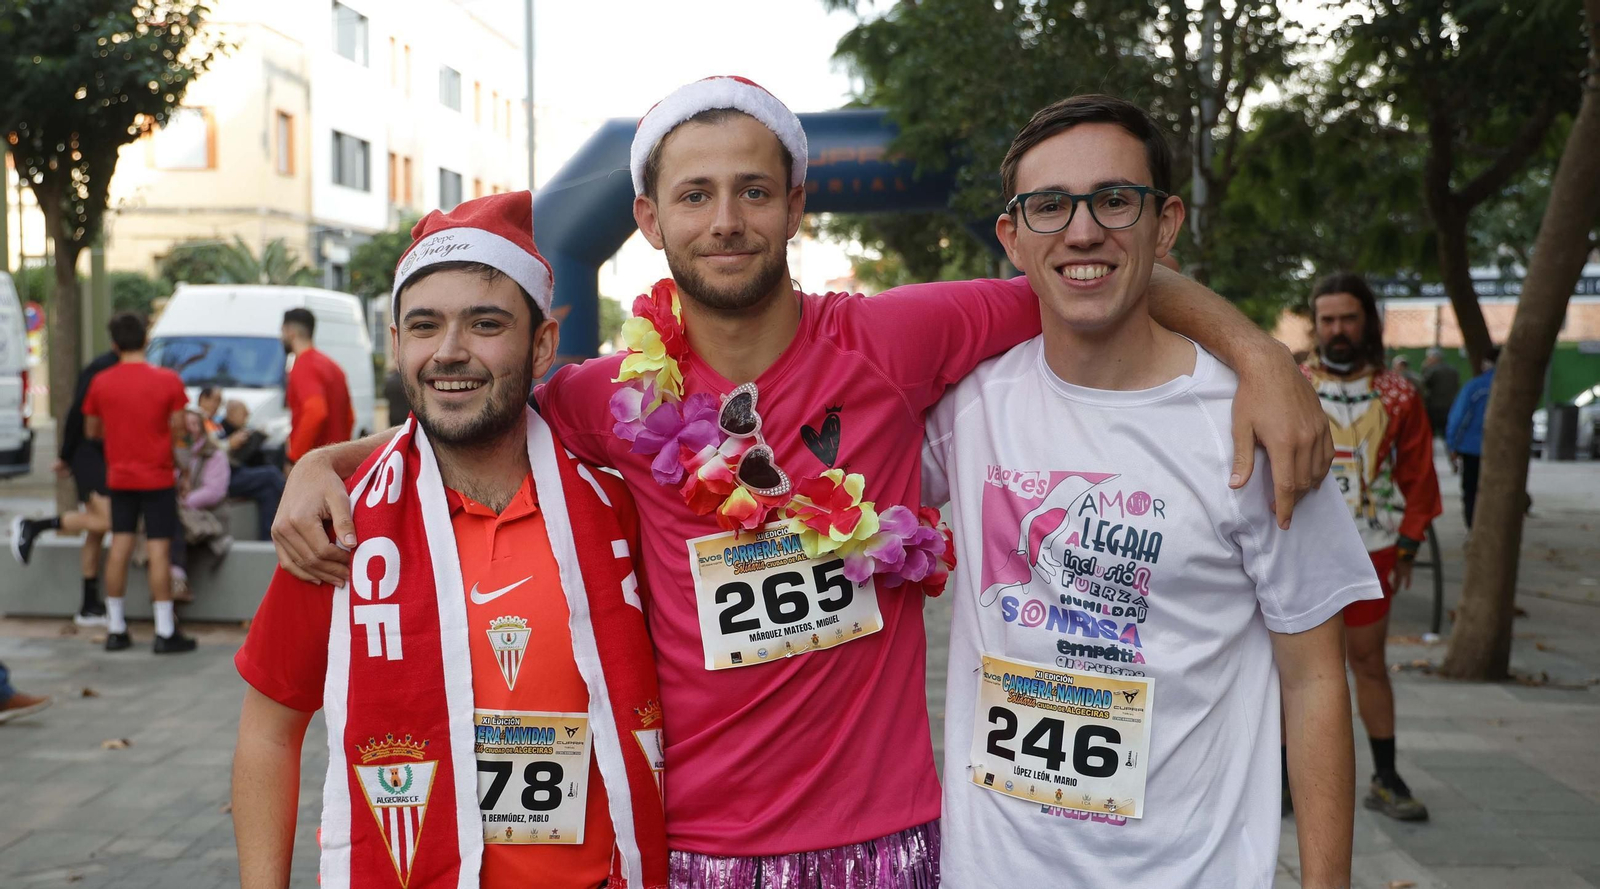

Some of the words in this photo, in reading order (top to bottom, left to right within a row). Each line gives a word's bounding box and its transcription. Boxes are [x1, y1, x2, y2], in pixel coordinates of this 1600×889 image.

[1078, 490, 1165, 519] AMOR
[765, 526, 790, 539] EDICIÓ
[724, 540, 779, 567] CARRERA
[766, 558, 788, 568] CIUDAD
[788, 556, 797, 564] DE
[714, 557, 854, 636] 265
[1061, 570, 1149, 608] FUERZA
[1001, 596, 1142, 648] SONRISA
[1060, 594, 1147, 624] HUMILDAD
[749, 627, 783, 643] MÁRQUEZ
[783, 621, 815, 636] MATEOS,
[816, 614, 840, 629] MIGUEL
[1035, 670, 1043, 678] XI
[1044, 671, 1074, 684] EDICIÓN
[1002, 672, 1053, 701] CARRERA
[1056, 683, 1113, 710] NAVIDAD
[481, 716, 490, 725] XI
[491, 716, 521, 726] EDICIÓN
[1036, 701, 1057, 712] CIUDAD
[1057, 705, 1066, 713] DE
[1066, 706, 1110, 719] ALGECIRAS
[504, 726, 556, 746] NAVIDAD
[986, 705, 1122, 779] 246
[514, 745, 554, 755] ALGECIRAS
[475, 760, 565, 811] 78
[1013, 766, 1032, 779] LÓPEZ
[1032, 770, 1052, 784] LEÓN,
[1053, 775, 1078, 787] MARIO
[488, 812, 527, 823] BERMÚDEZ,
[528, 814, 550, 823] PABLO
